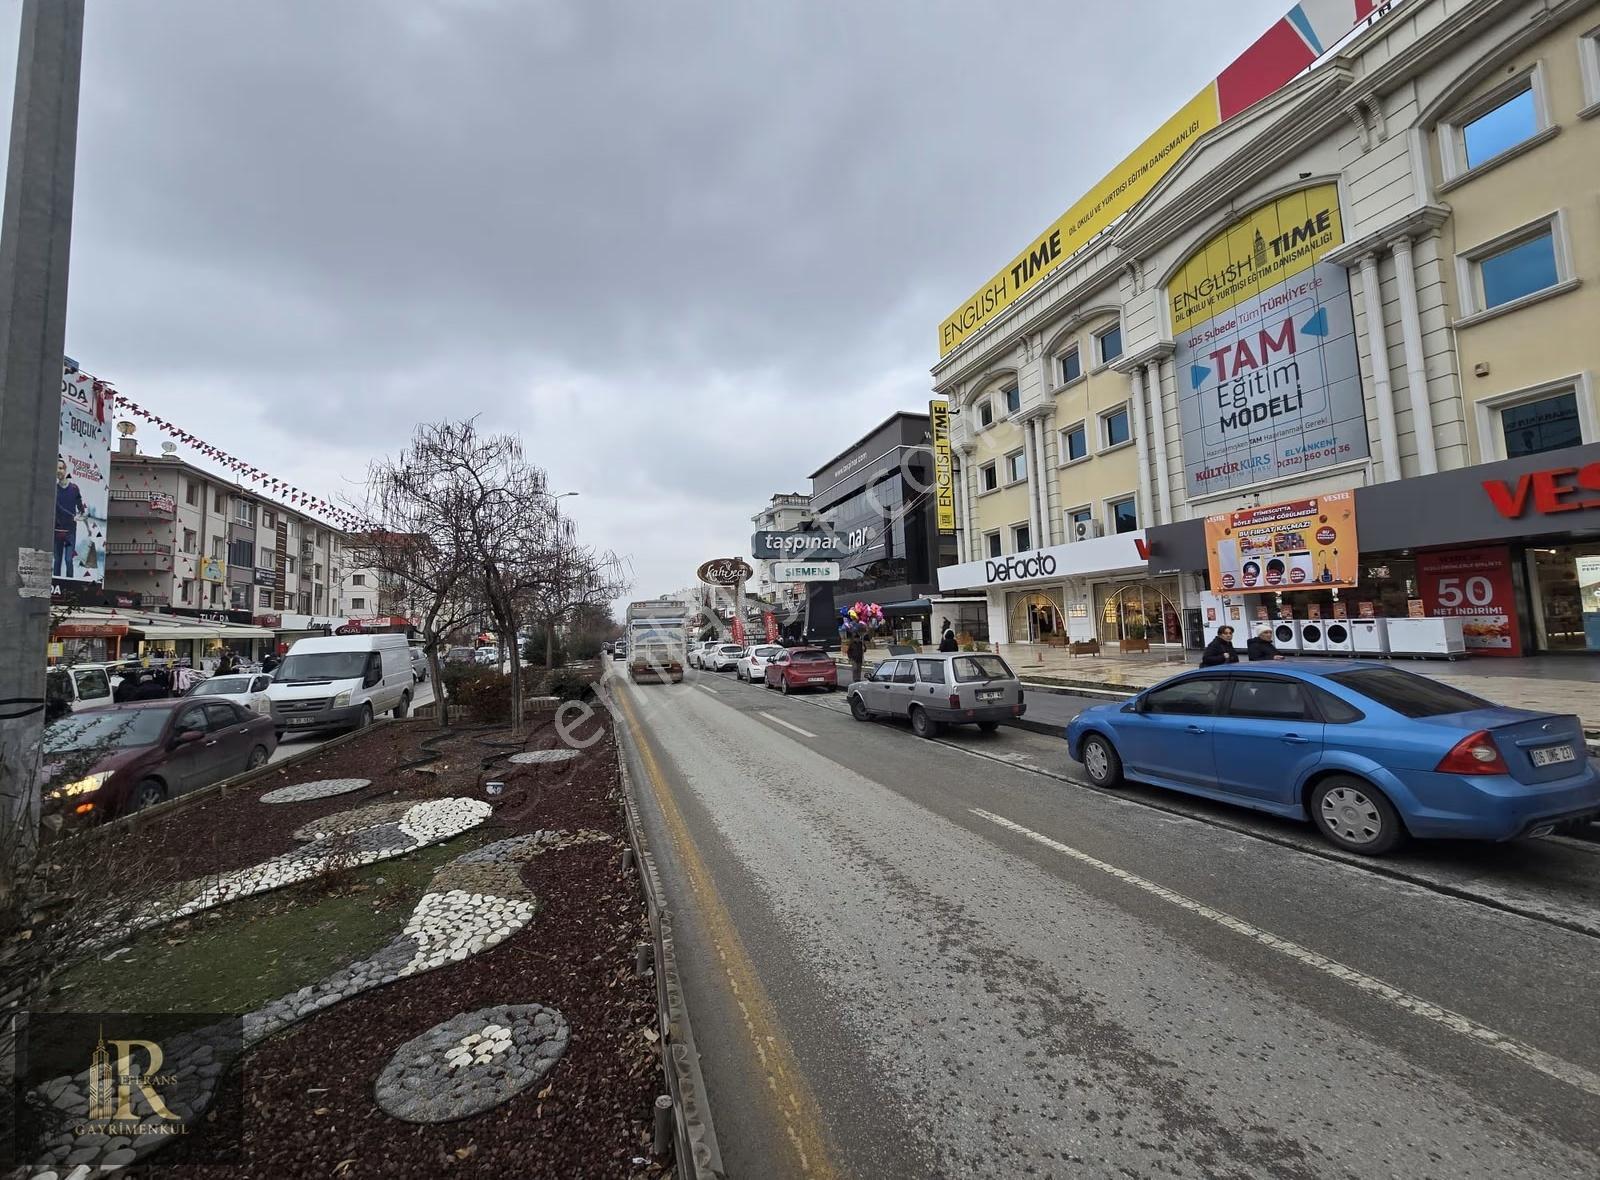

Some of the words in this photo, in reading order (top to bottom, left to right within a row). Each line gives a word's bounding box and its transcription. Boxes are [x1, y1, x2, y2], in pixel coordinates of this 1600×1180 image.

[1077, 209, 1094, 229] OKULU
[1094, 202, 1102, 213] VE
[1173, 254, 1253, 313] ENGLISH
[1269, 208, 1331, 257] TIME
[943, 276, 1007, 347] ENGLISH
[1011, 229, 1062, 290] TIME
[1175, 312, 1186, 323] DİL
[1186, 302, 1208, 317] OKULU
[1208, 297, 1215, 307] VE
[1216, 280, 1247, 301] YURTDIŞI
[1247, 265, 1273, 284] EĞİTİM
[1273, 231, 1333, 271] DANIŞMANLIĞI
[1204, 319, 1236, 342] Şubede
[1238, 308, 1260, 325] Tüm
[1209, 316, 1297, 382] TAM
[1217, 361, 1300, 409] Eğitim
[934, 406, 948, 441] TIME
[1220, 384, 1303, 433] MODELİ
[1239, 453, 1271, 471] KURS
[1285, 437, 1338, 457] ELVANKENT
[936, 445, 952, 507] ENGLISH
[1323, 492, 1351, 503] VESTEL
[765, 533, 841, 553] taşpınar
[1239, 529, 1249, 538] BU
[785, 567, 830, 577] SIEMENS
[985, 551, 1057, 583] DeFacto
[1438, 576, 1493, 607] 50
[1433, 607, 1453, 616] NET
[1455, 606, 1503, 616] İNDİRİM!
